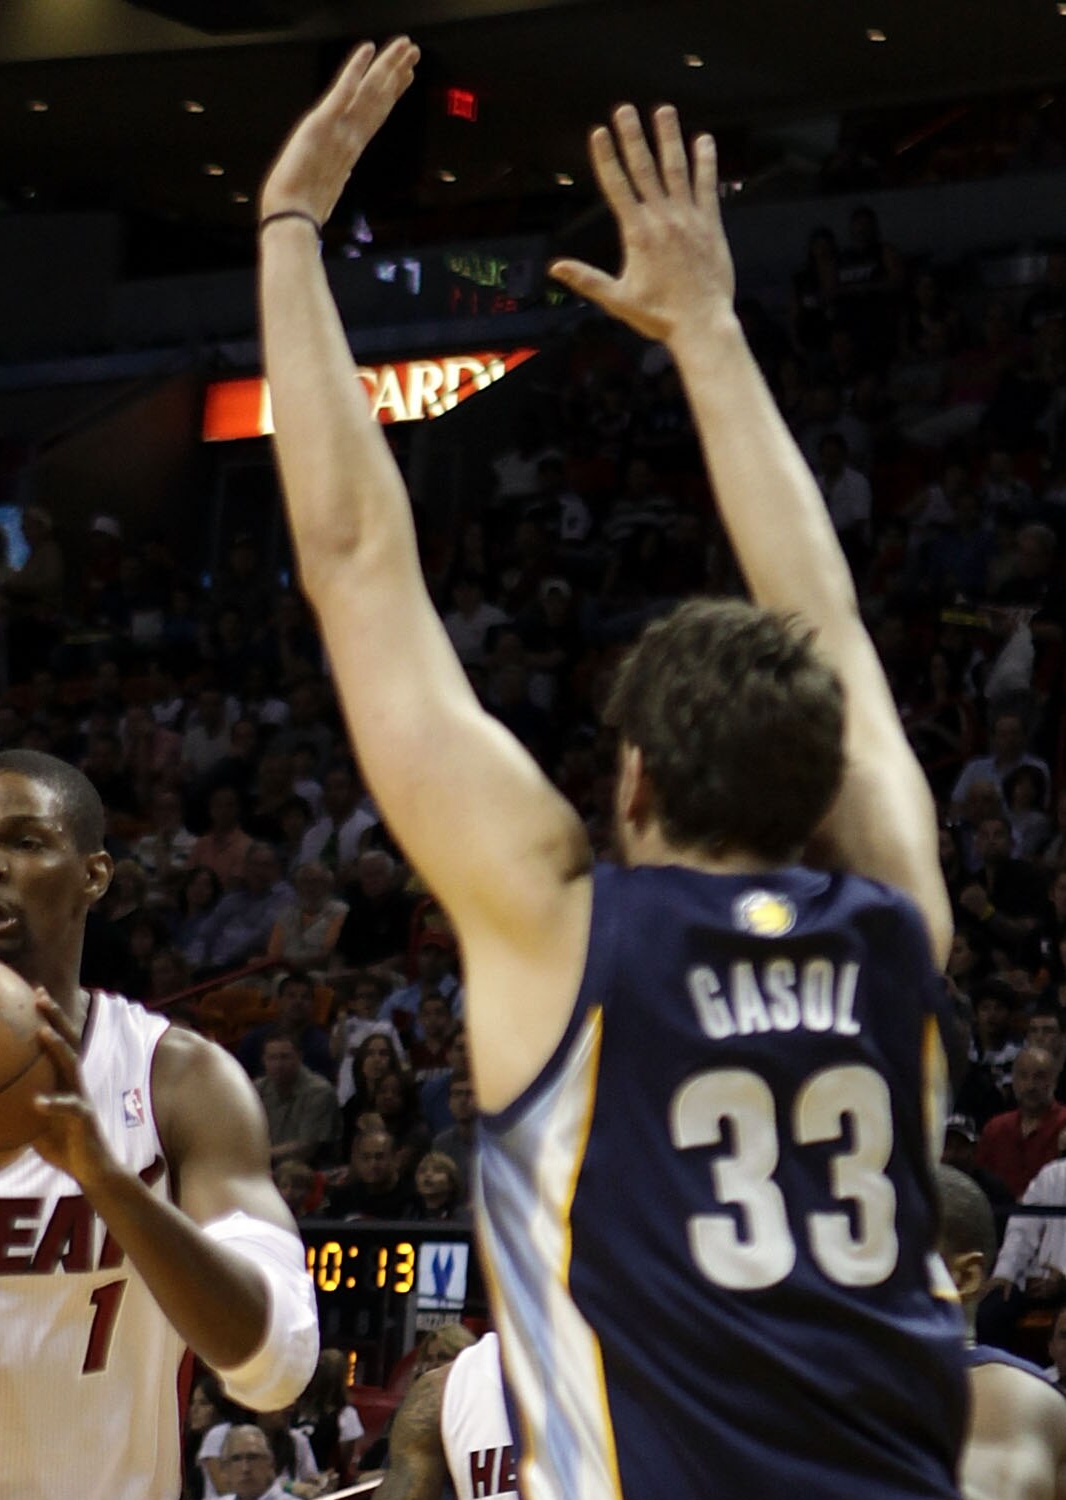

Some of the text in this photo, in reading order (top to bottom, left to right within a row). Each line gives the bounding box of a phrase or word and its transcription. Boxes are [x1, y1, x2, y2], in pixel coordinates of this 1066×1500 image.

[687, 954, 862, 1040] GASOL
[669, 1063, 899, 1291] 33
[83, 1279, 128, 1375] 1
